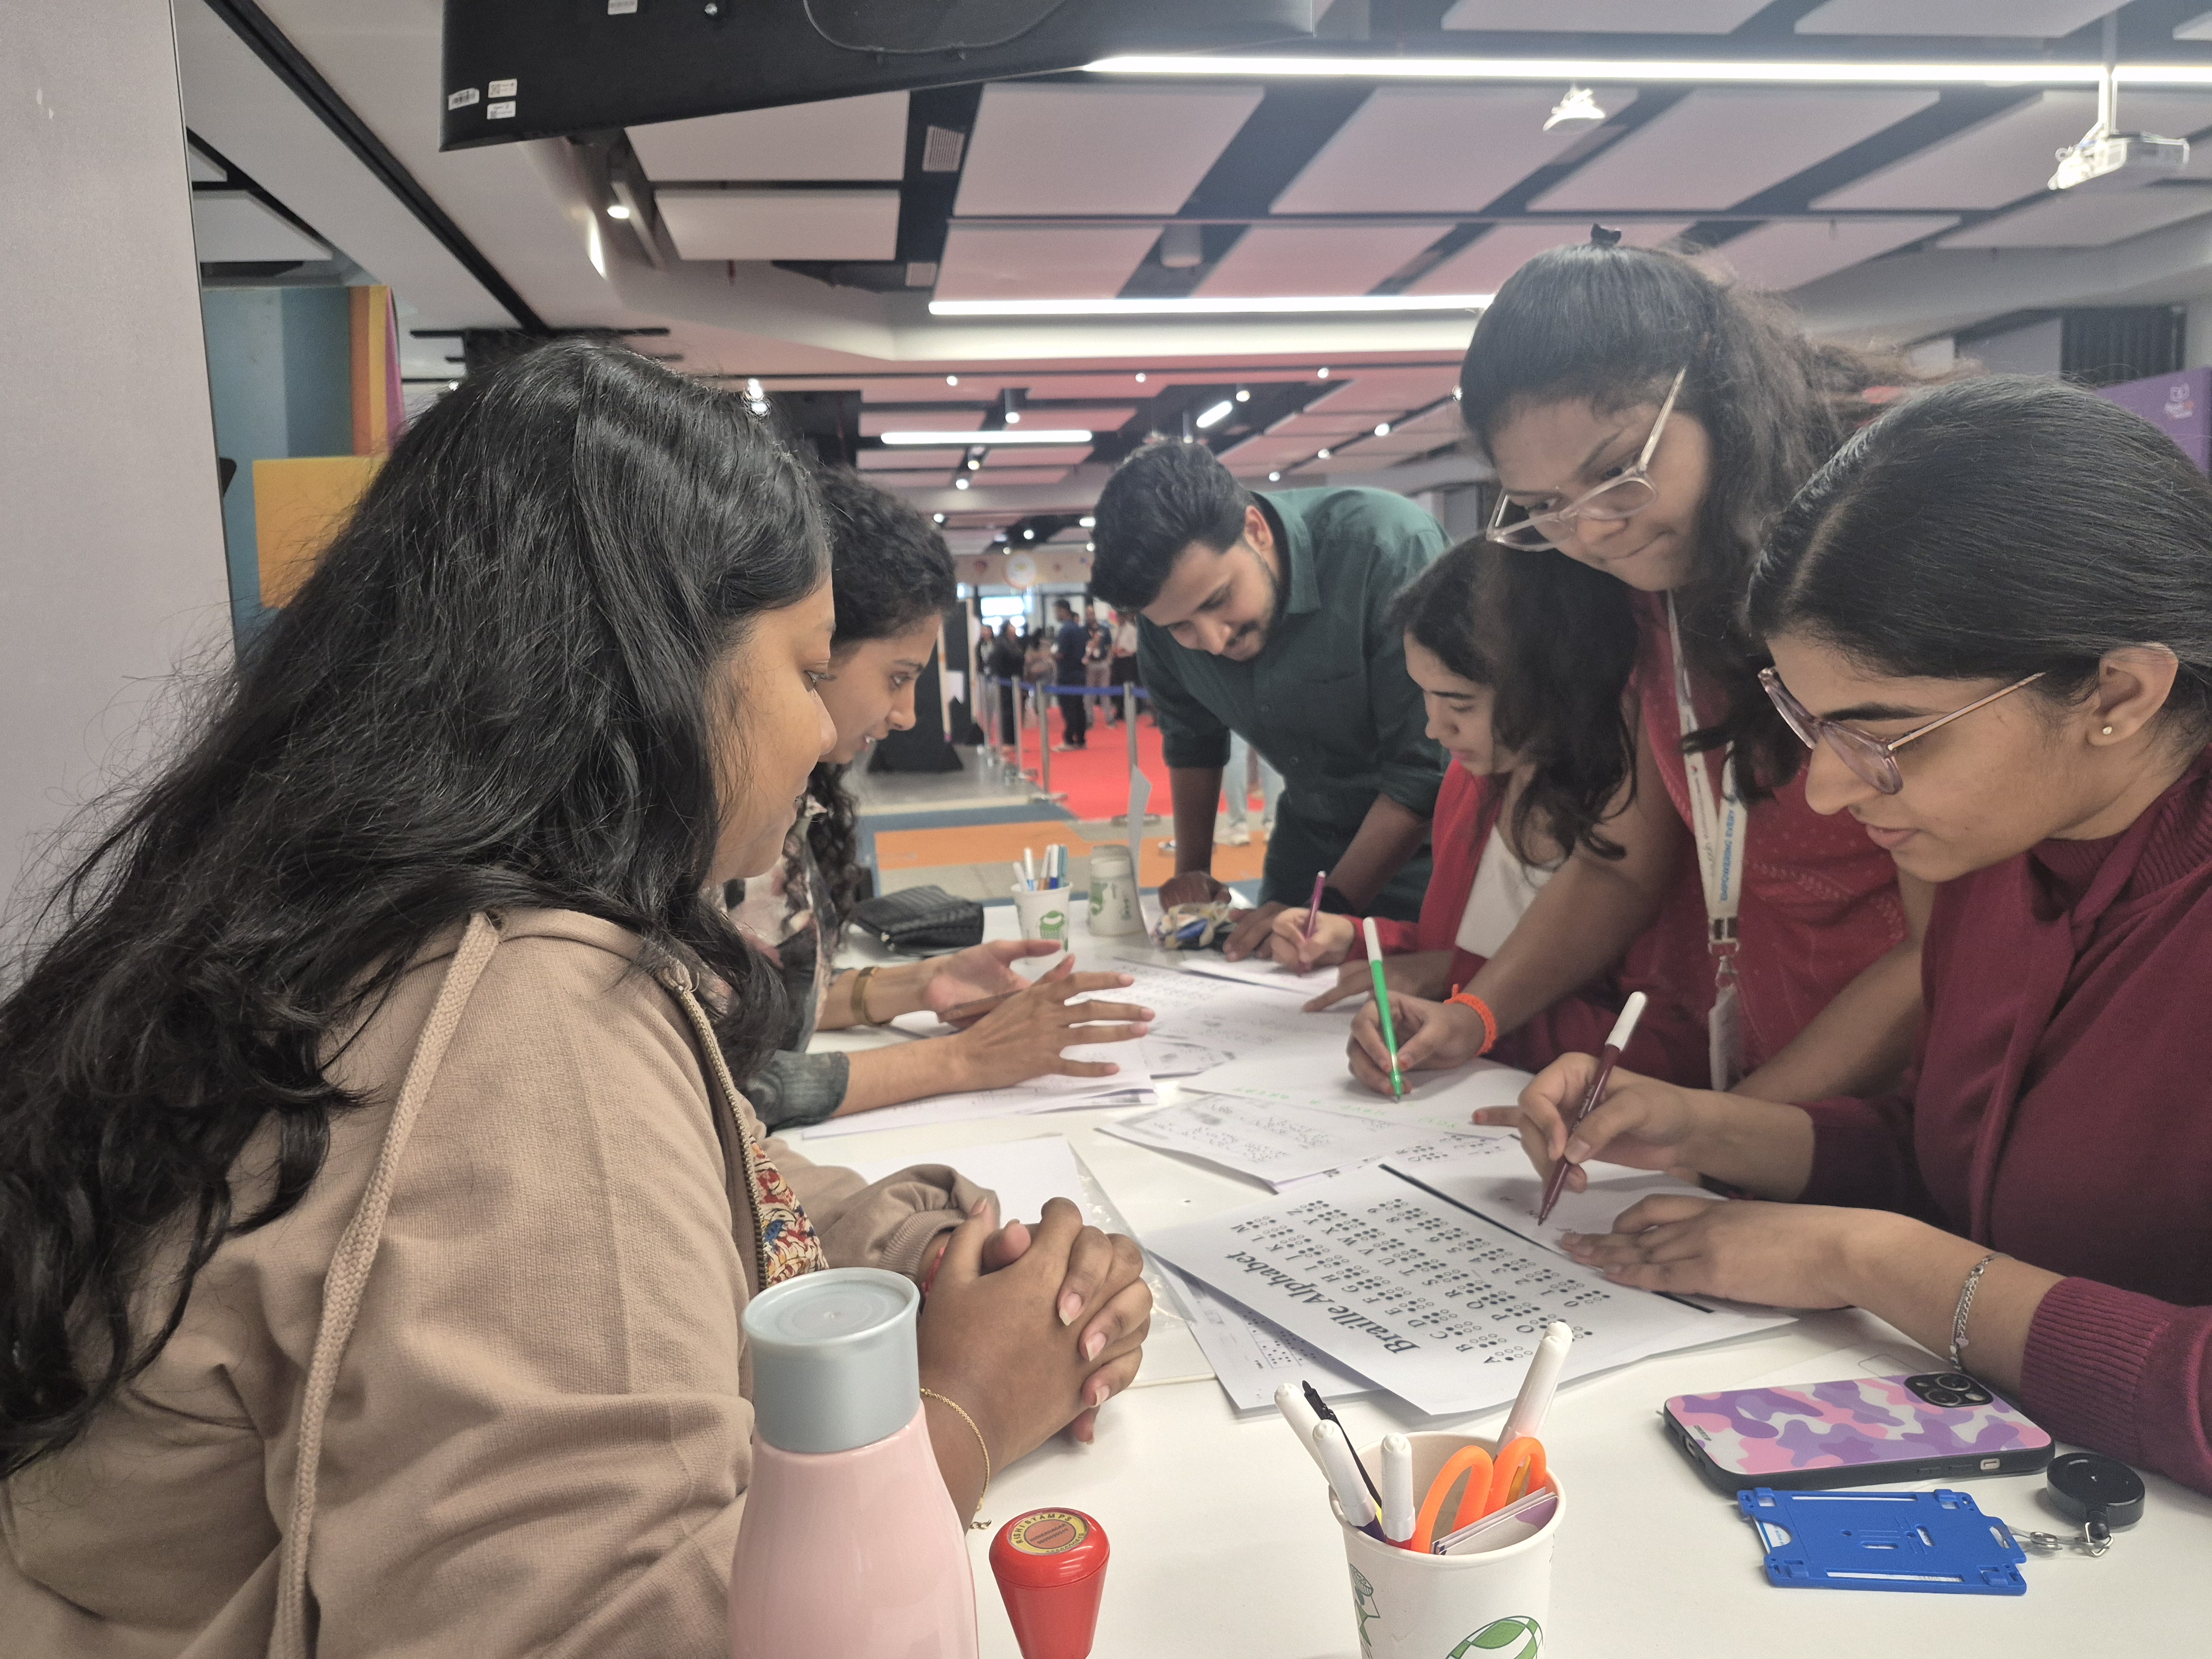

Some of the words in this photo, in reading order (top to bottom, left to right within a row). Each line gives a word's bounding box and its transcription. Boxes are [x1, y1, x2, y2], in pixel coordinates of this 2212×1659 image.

[1230, 1224, 1250, 1233] M
[1337, 1237, 1357, 1245] W
[1265, 1244, 1284, 1252] K
[1377, 1258, 1396, 1266] U
[1224, 1250, 1335, 1303] Alphabet
[1444, 1289, 1462, 1298] R
[1466, 1300, 1484, 1310] Q
[1407, 1319, 1427, 1327] D
[1327, 1305, 1421, 1354] Braille
[1430, 1331, 1448, 1339] C
[1455, 1344, 1474, 1352] B
[1013, 1524, 1026, 1544] RISHI
[1025, 1514, 1072, 1525] STAMPS
